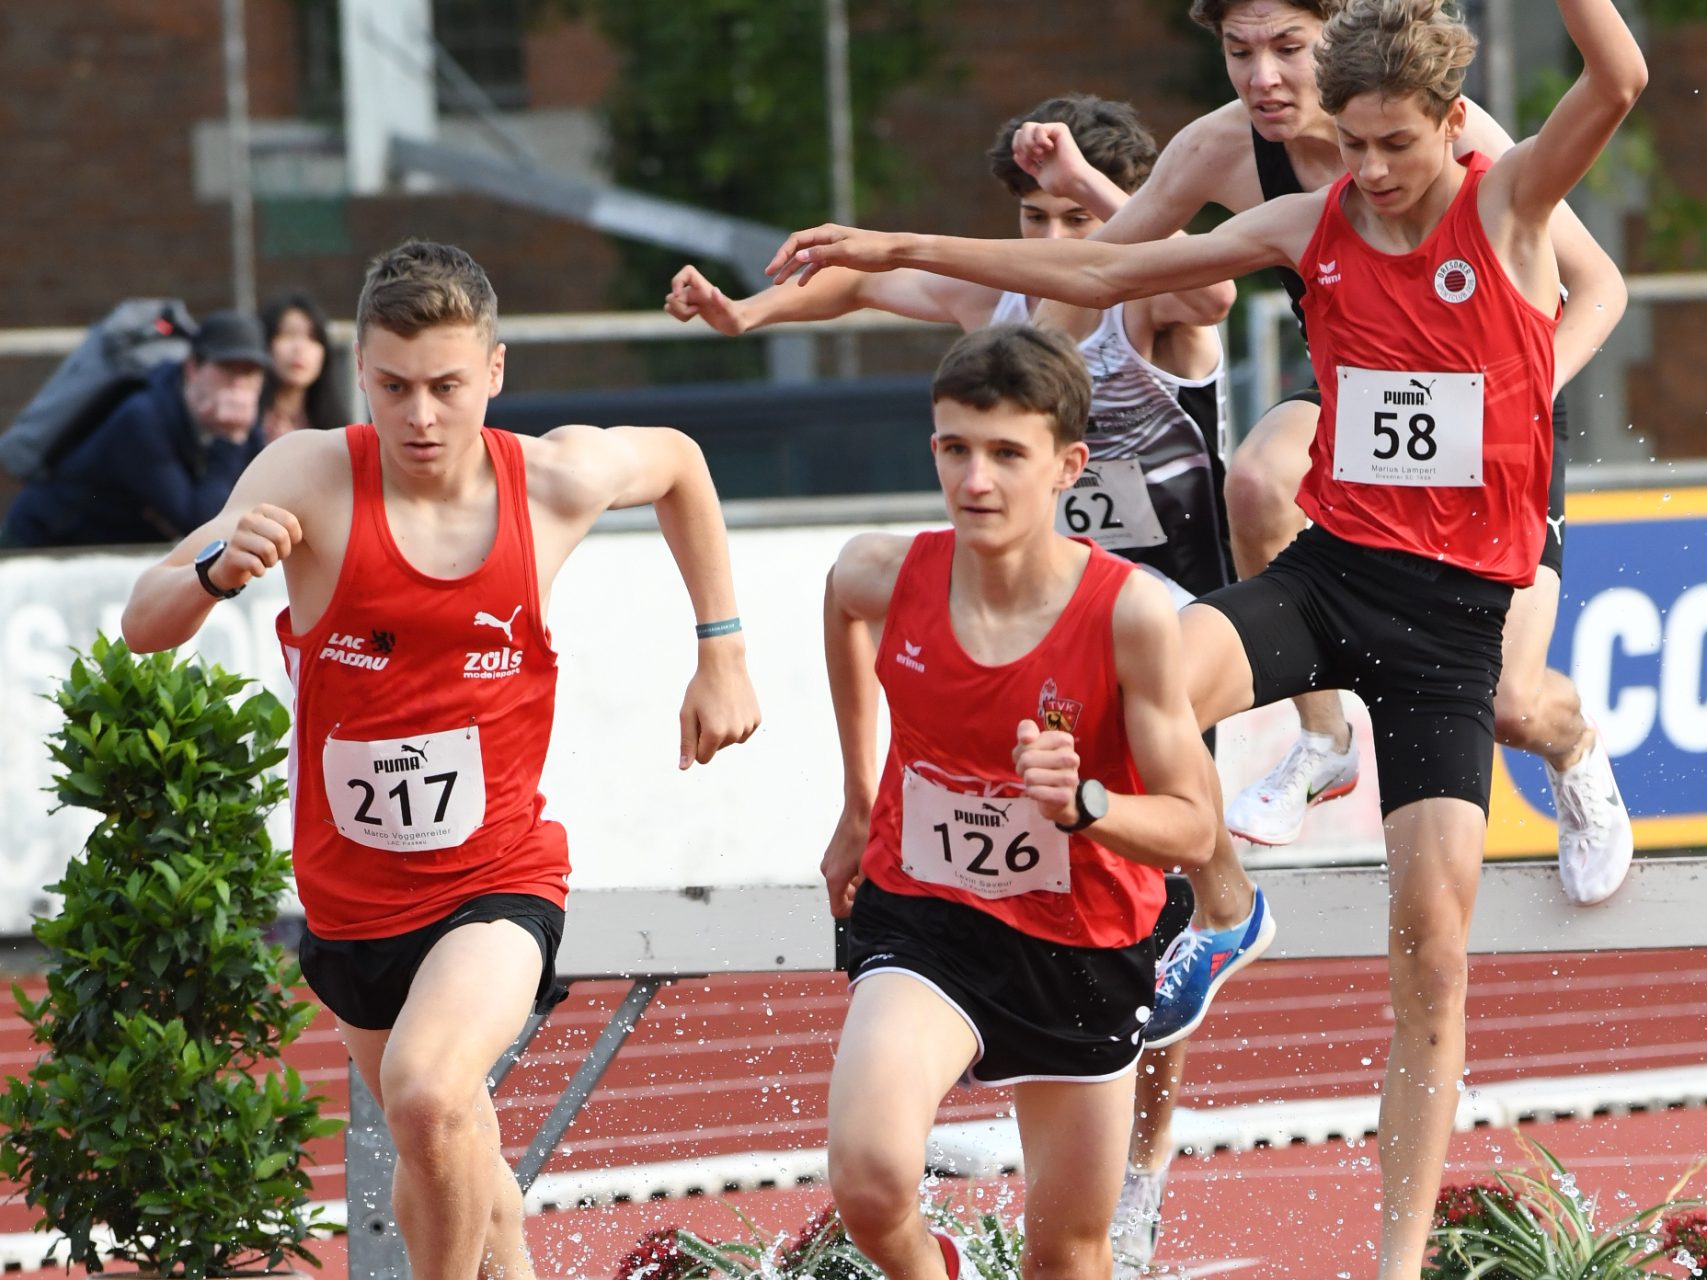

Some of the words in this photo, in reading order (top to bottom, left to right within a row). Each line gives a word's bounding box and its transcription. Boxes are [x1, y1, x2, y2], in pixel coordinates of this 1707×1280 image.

[1384, 390, 1425, 405] PUMA
[1372, 412, 1437, 461] 58
[1371, 465, 1398, 473] Marius
[1402, 466, 1436, 474] Lampert
[1065, 492, 1124, 533] 62
[328, 632, 365, 650] LAC
[319, 647, 390, 671] PASSAU
[896, 653, 926, 673] erima
[1049, 700, 1074, 711] TVK
[373, 756, 421, 774] PUMA
[347, 771, 459, 827] 217
[954, 810, 1001, 828] PUMA
[363, 828, 389, 839] Marco
[933, 822, 1041, 876] 126
